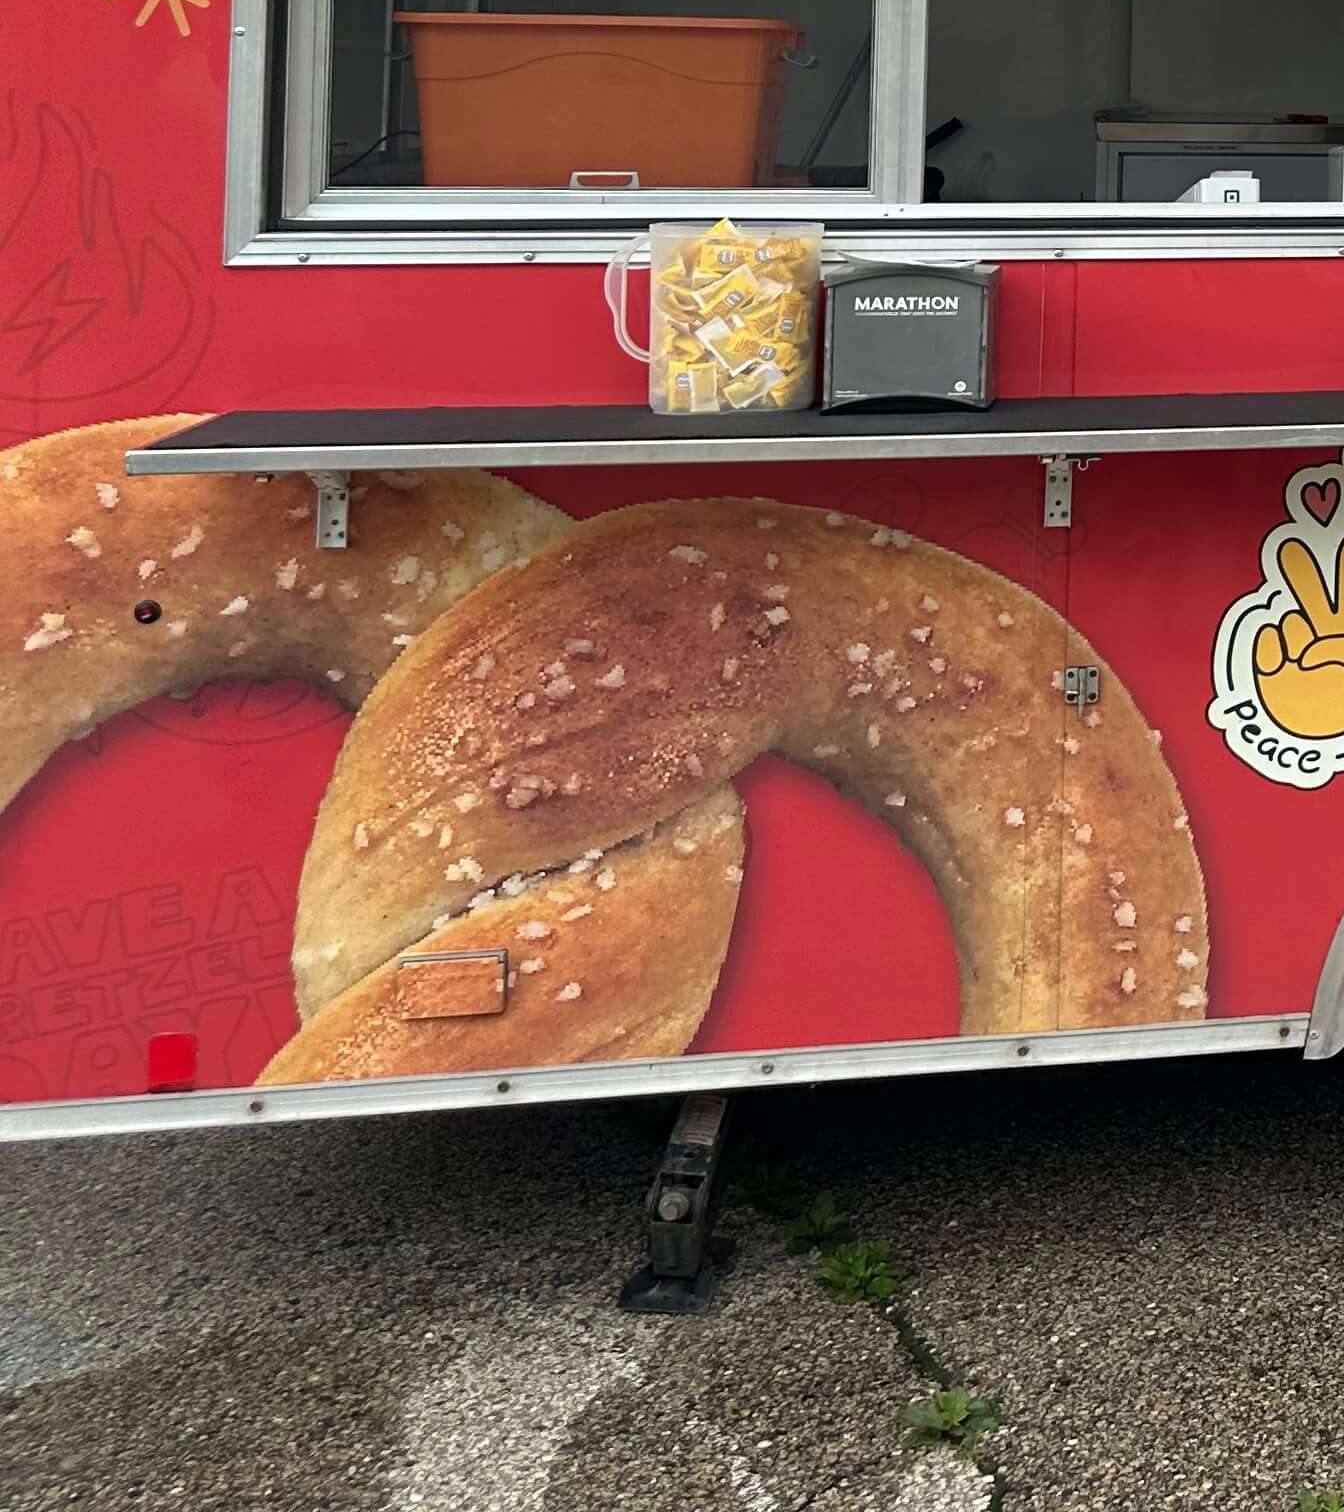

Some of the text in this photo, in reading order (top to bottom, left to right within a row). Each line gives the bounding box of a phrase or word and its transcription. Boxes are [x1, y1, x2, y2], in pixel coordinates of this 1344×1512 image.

[854, 296, 960, 311] MARATHON
[1223, 698, 1323, 774] Peace
[0, 881, 195, 989] AVE
[0, 934, 293, 1046] RETZEL
